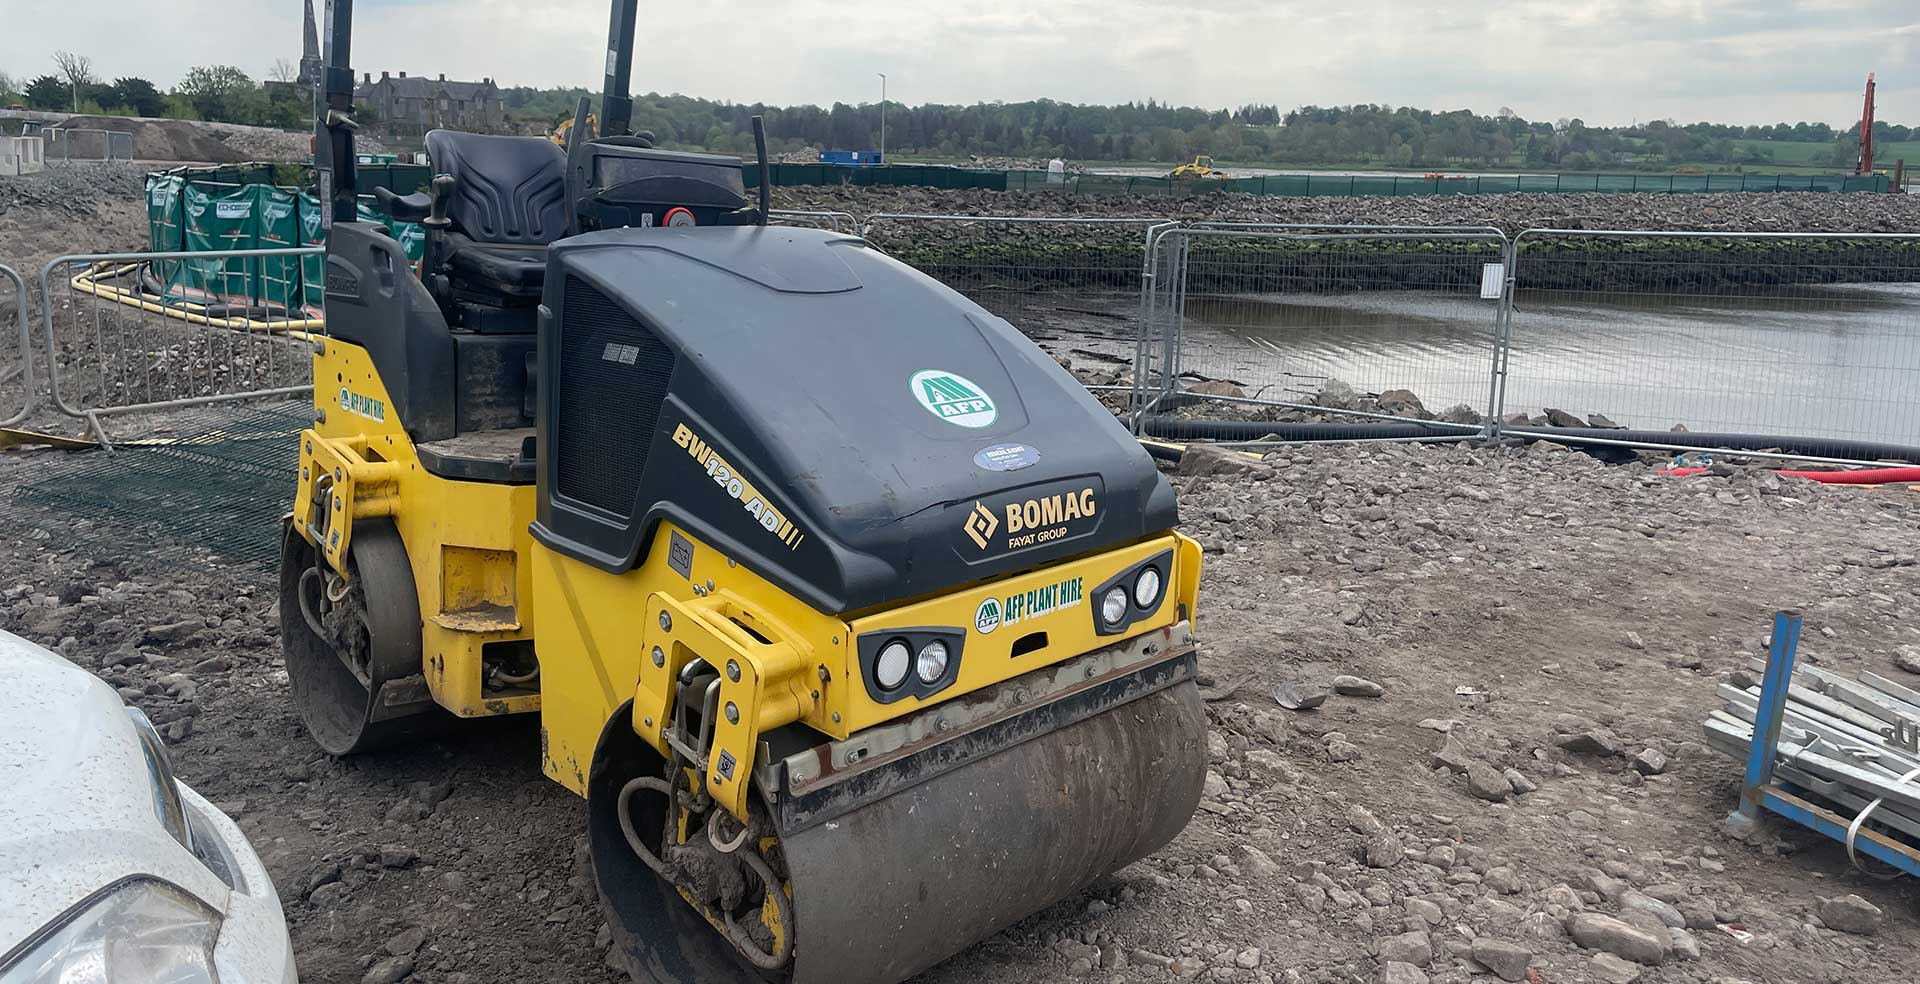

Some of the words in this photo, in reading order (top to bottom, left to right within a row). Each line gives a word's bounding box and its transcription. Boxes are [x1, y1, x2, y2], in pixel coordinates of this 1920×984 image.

[940, 400, 987, 417] AFP
[744, 497, 779, 532] AD
[1006, 488, 1096, 533] BOMAG
[1009, 534, 1036, 549] FAYAT
[1037, 526, 1068, 543] GROUP
[1005, 593, 1024, 621] AFP
[1026, 584, 1058, 615] PLANT
[1060, 577, 1083, 605] HIRE
